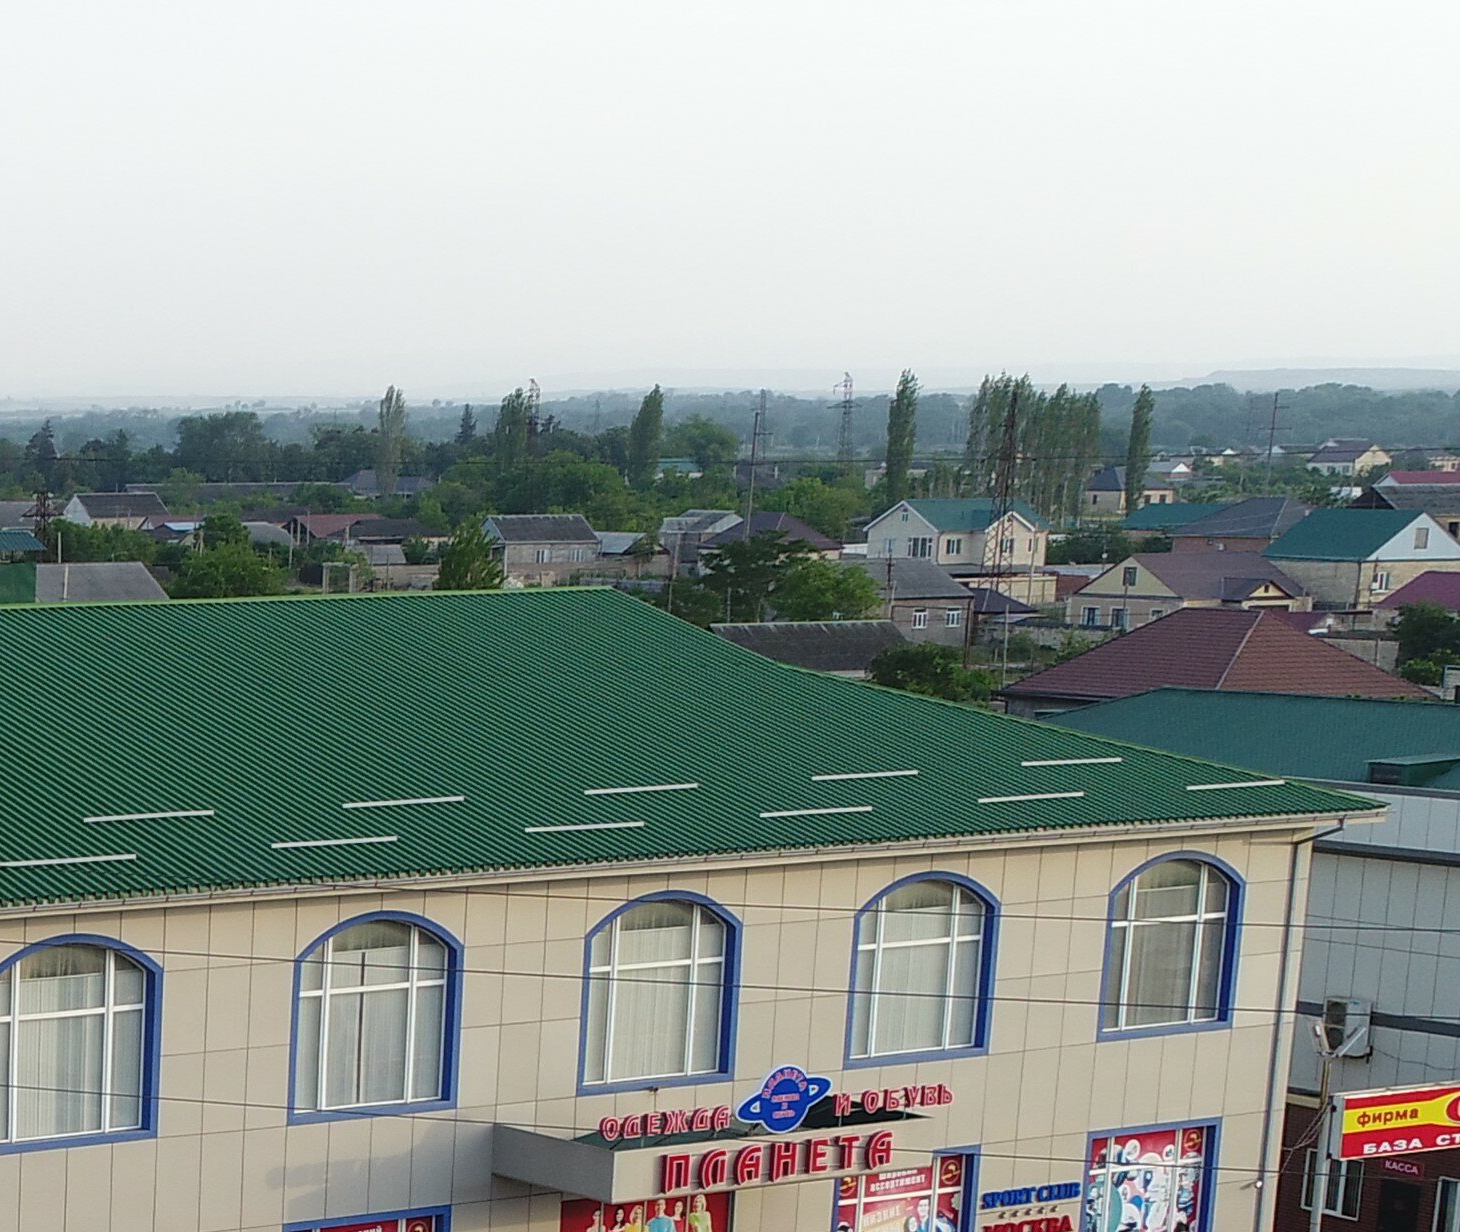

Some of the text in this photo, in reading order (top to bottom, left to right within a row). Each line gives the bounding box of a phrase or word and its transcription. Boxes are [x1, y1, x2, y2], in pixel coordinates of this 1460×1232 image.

[599, 1084, 953, 1141] ОДЕЖДА И ОБУВЬ
[1357, 1107, 1419, 1128] фирма
[1363, 1138, 1423, 1154] БАЗА
[661, 1130, 894, 1195] ПЛАНЕТА
[1385, 1160, 1419, 1175] КАССА
[981, 1182, 1081, 1209] SPORT CLUB
